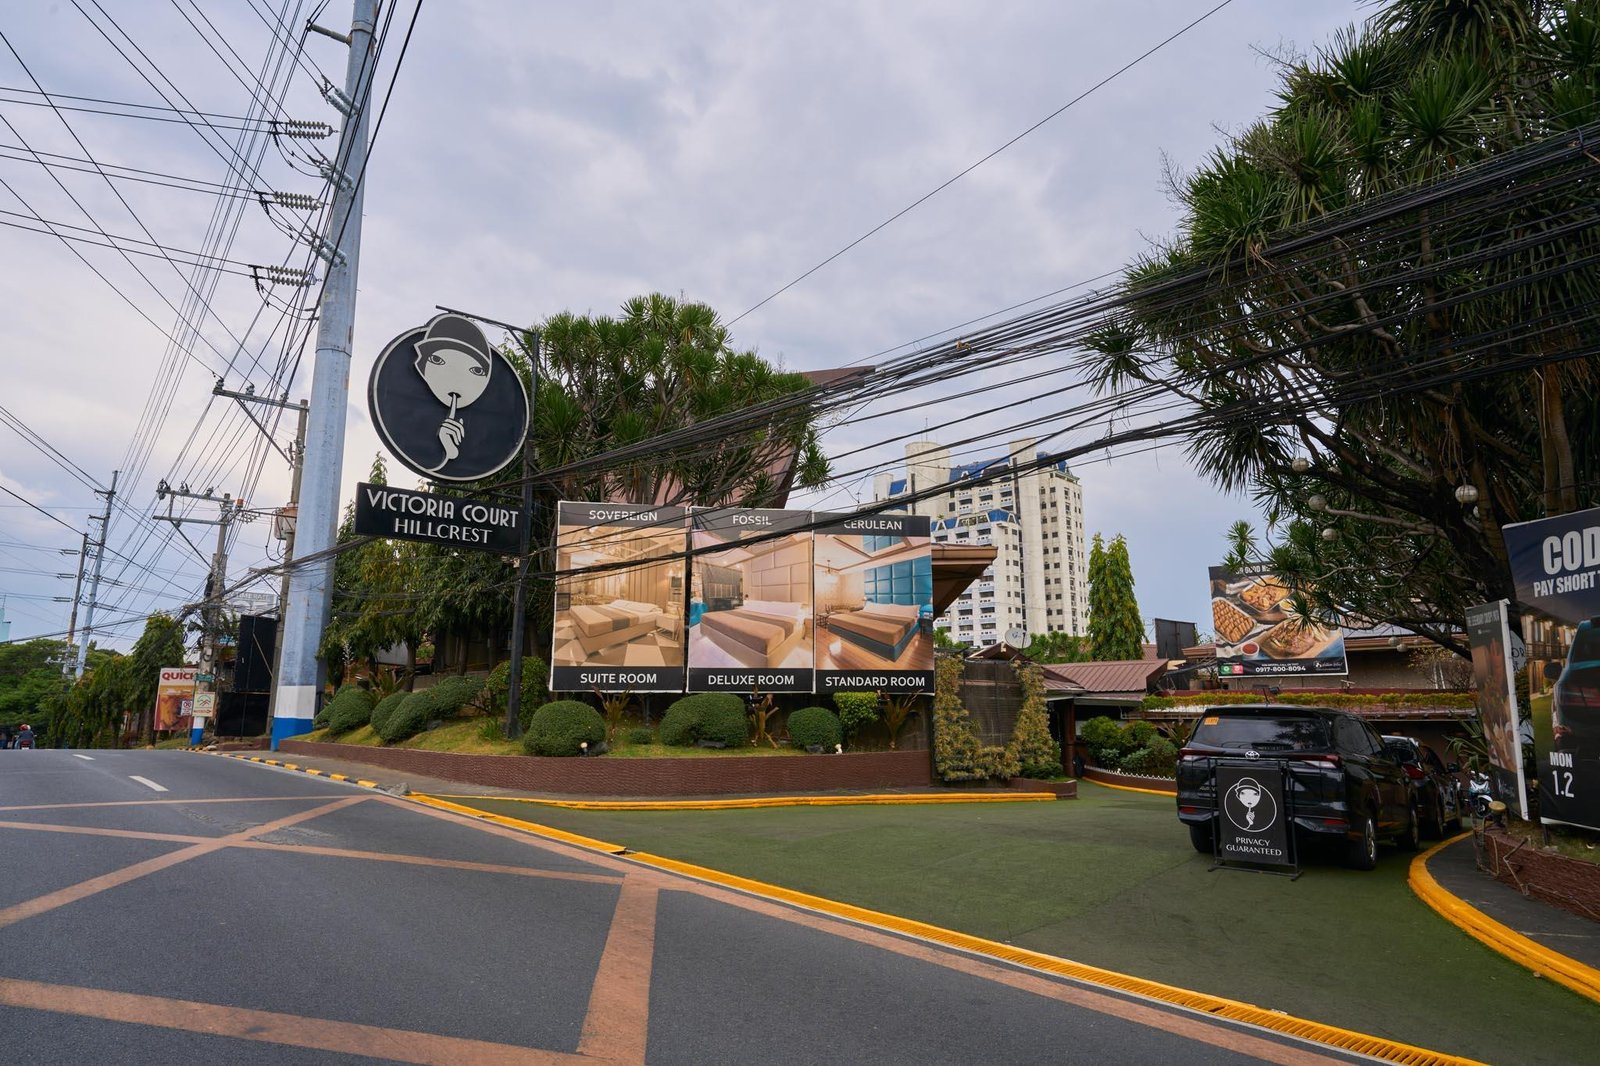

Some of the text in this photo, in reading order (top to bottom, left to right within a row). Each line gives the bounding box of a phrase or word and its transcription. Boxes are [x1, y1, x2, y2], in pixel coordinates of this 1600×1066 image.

[366, 488, 519, 528] VICTORIA COURT
[588, 510, 658, 521] SOVEREIGN
[732, 515, 772, 526] FOSSIL
[844, 519, 903, 530] CERULEAN
[394, 517, 493, 544] HILLCREST
[1543, 526, 1600, 575] COD
[1533, 579, 1555, 598] PAY
[1556, 571, 1596, 594] SHORT
[580, 673, 657, 684] SUITE ROOM
[708, 675, 795, 685] DELUXE ROOM
[825, 676, 925, 687] STANDARD ROOM
[1549, 751, 1573, 768] MON
[1235, 836, 1271, 847] PRIVACY
[1225, 844, 1282, 856] GUARANTEED
